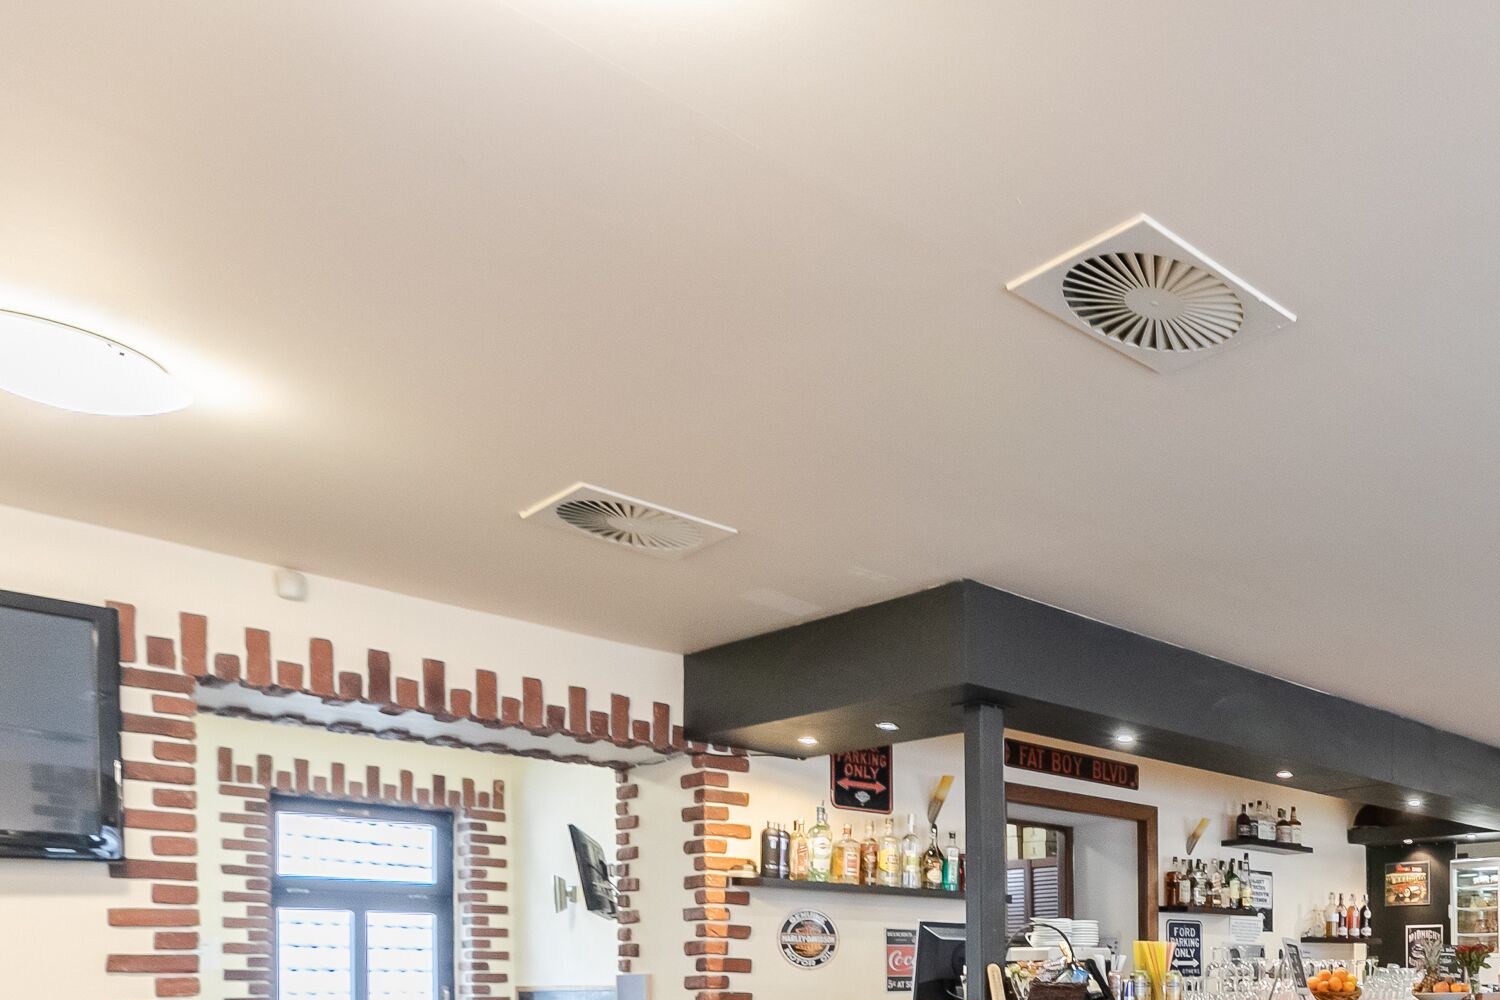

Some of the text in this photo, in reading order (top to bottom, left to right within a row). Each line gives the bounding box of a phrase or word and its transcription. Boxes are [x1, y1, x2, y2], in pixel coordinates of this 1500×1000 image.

[1019, 745, 1045, 769] FAT
[1051, 751, 1082, 776] BOY
[844, 763, 879, 780] ONLY
[1173, 926, 1196, 937] FORD
[1170, 937, 1200, 948] PARKING
[1174, 947, 1196, 958] ONLY
